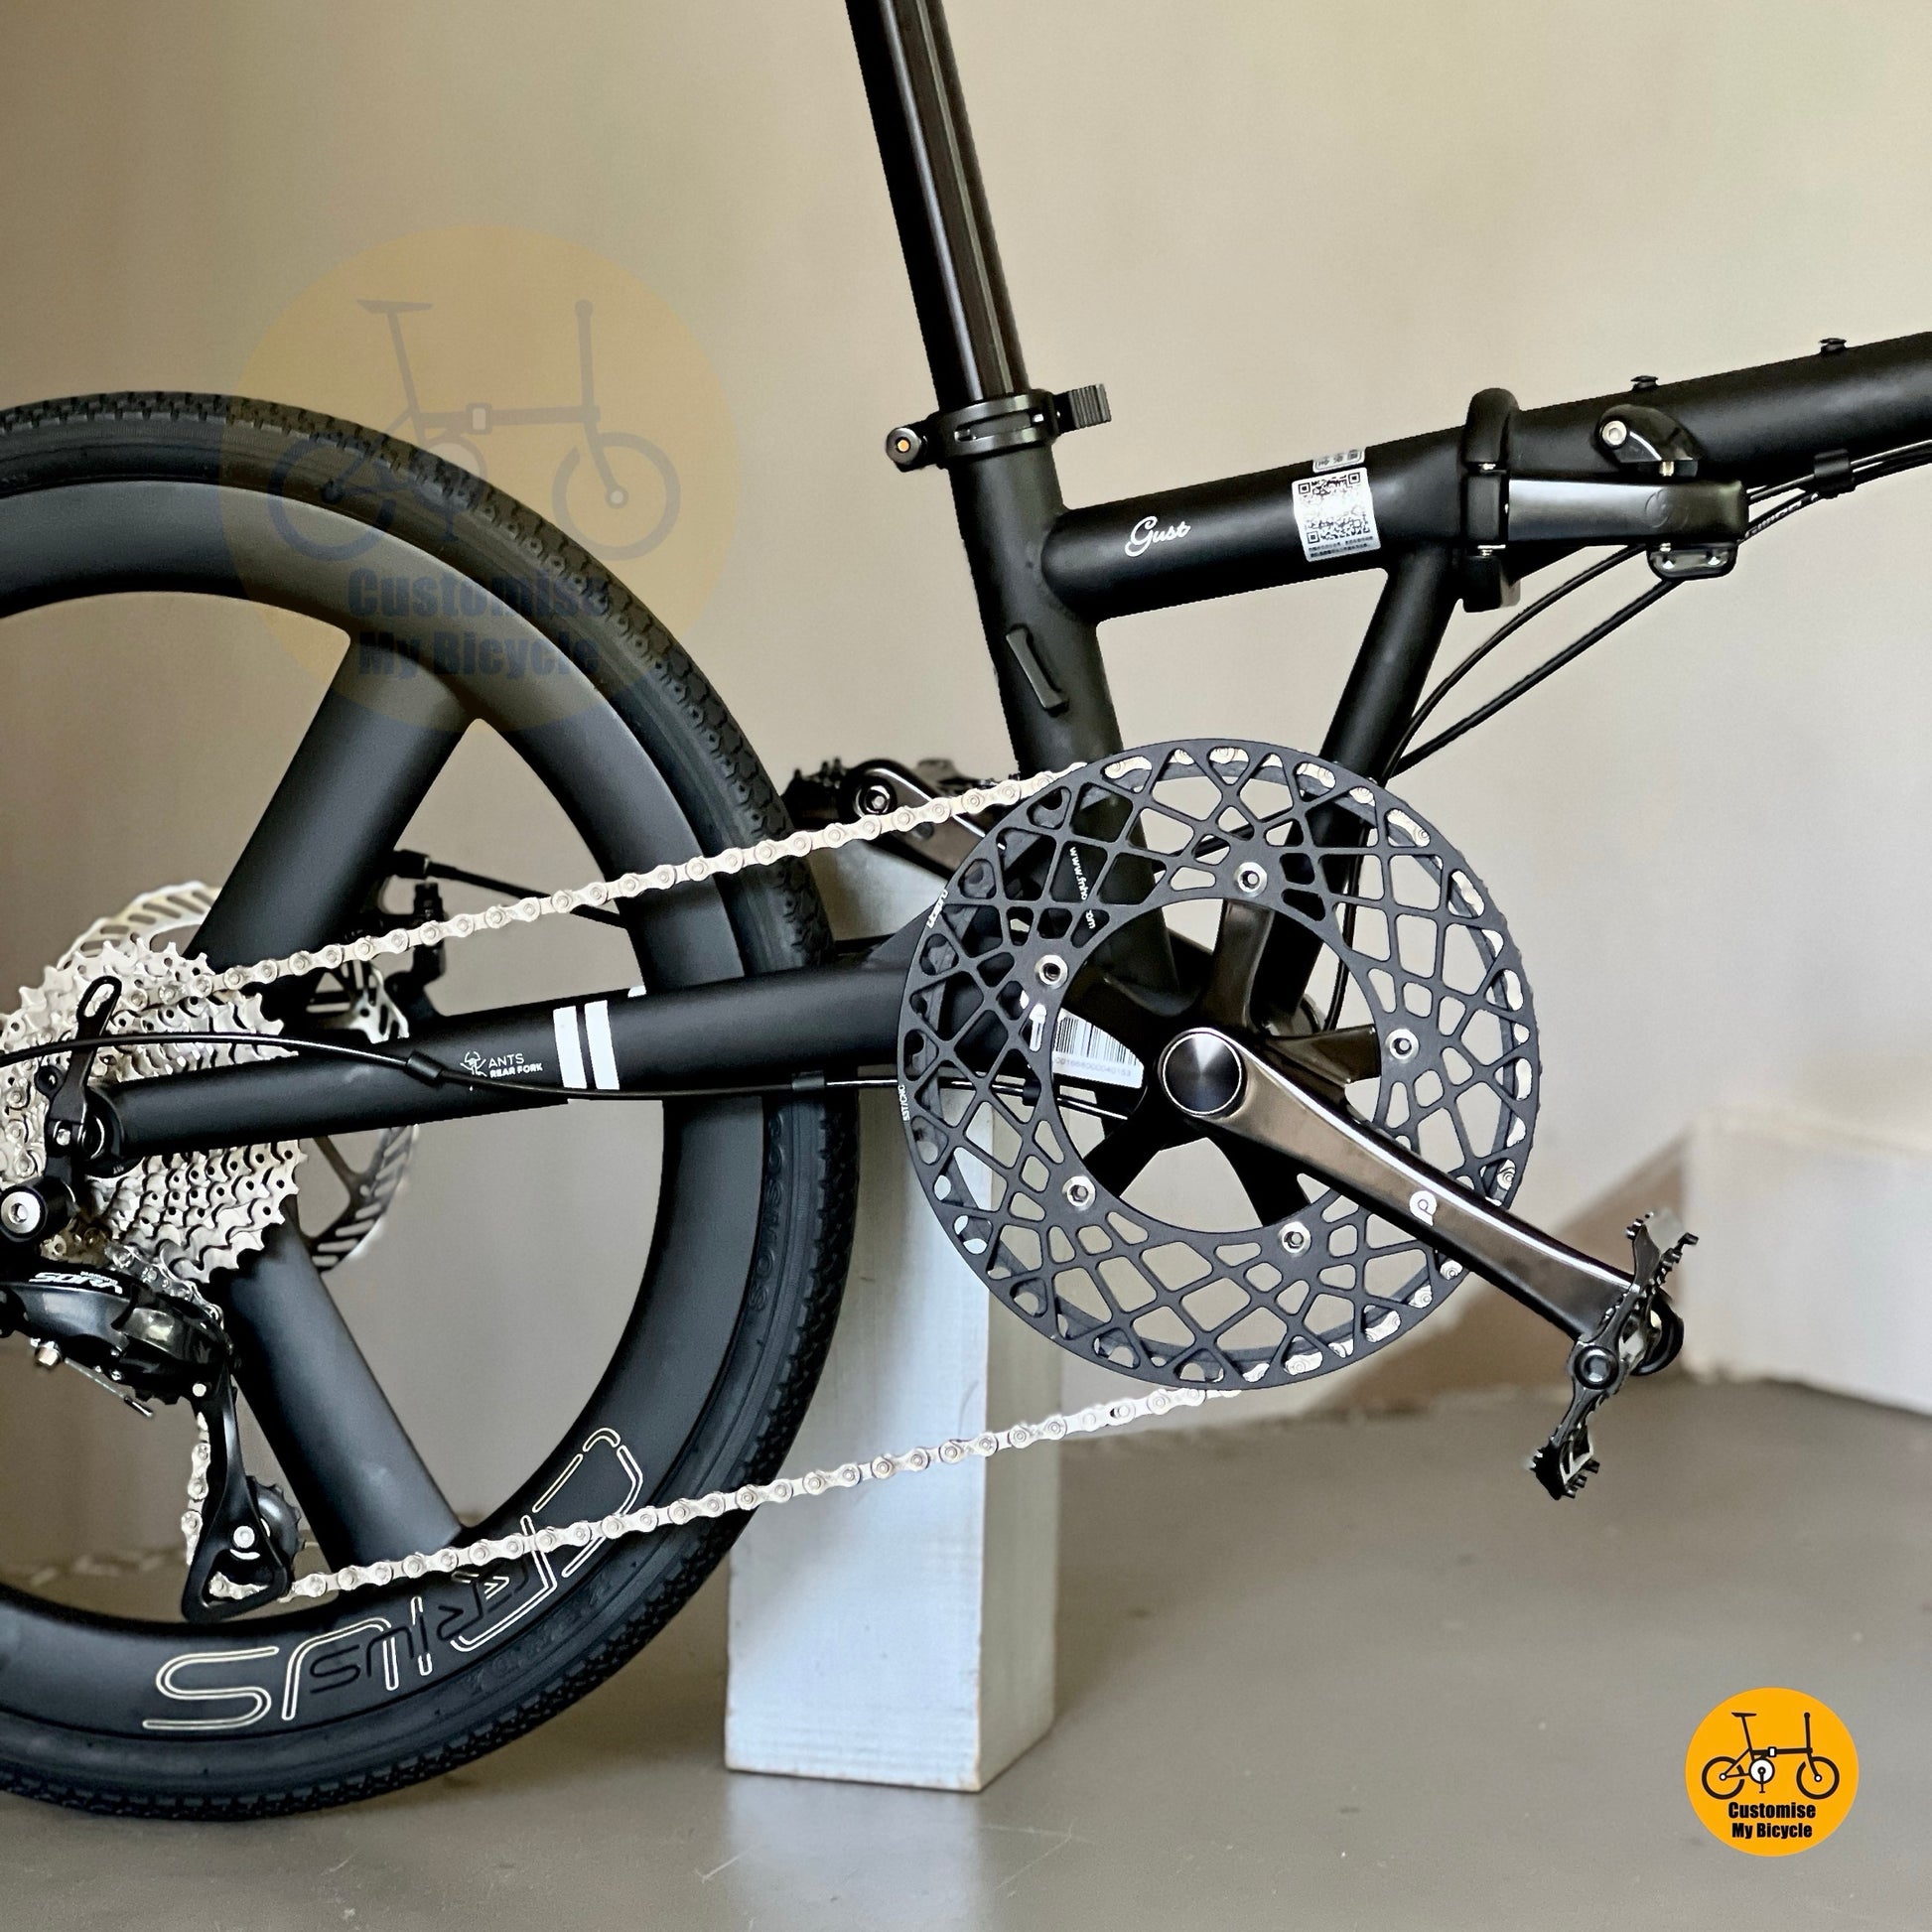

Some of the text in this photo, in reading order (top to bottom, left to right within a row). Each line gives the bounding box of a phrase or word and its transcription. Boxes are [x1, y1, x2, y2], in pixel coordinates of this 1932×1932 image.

[1124, 515, 1191, 557] Gust
[488, 1052, 525, 1069] ANTS
[516, 1062, 543, 1074] FORK
